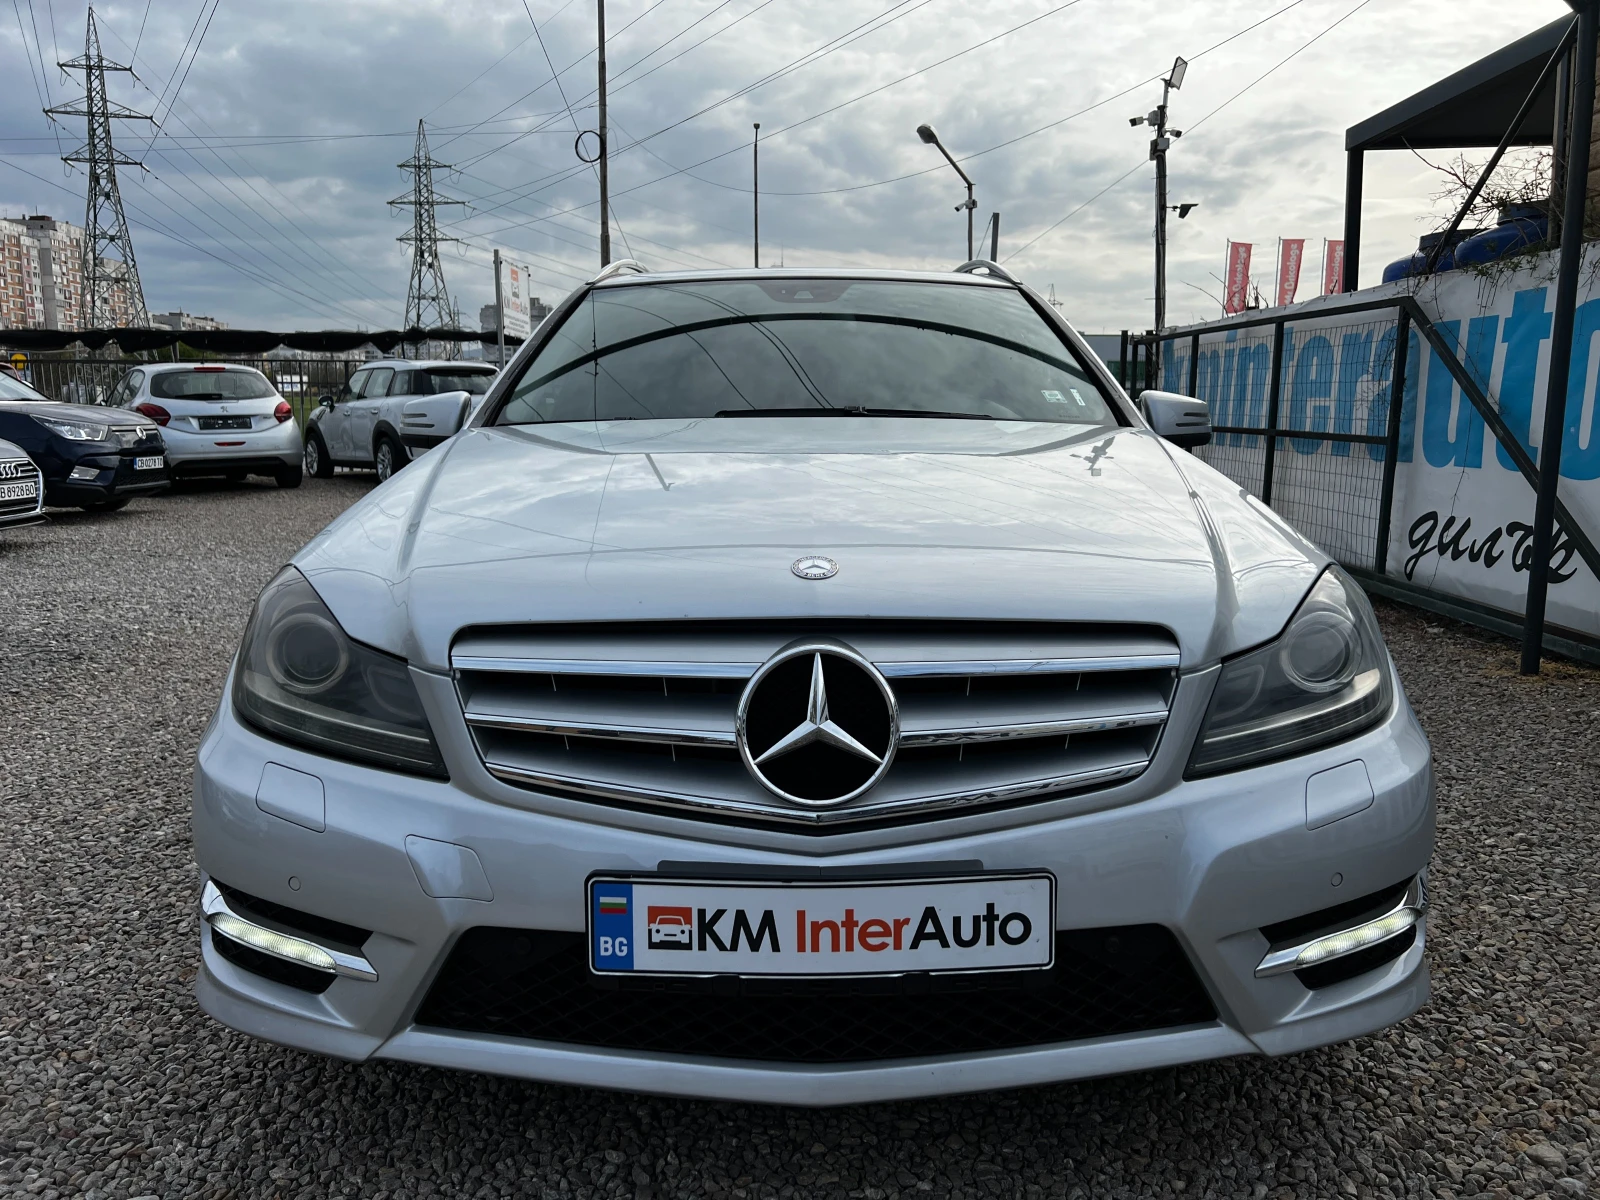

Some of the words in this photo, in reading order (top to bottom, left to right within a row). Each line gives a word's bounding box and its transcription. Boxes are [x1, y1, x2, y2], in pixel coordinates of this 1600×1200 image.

[7, 485, 25, 498] 8928
[697, 908, 781, 953] KM
[796, 902, 1032, 953] InterAuto
[599, 936, 628, 957] BG
